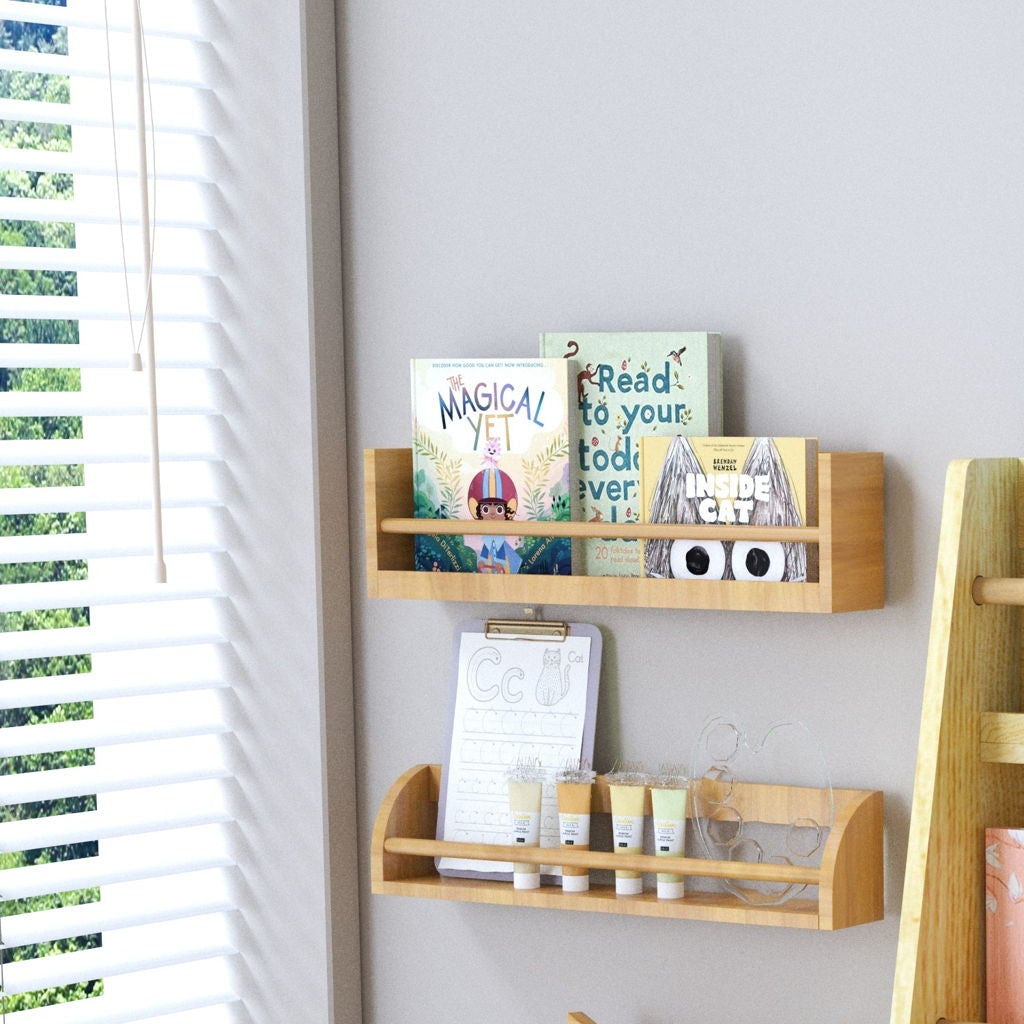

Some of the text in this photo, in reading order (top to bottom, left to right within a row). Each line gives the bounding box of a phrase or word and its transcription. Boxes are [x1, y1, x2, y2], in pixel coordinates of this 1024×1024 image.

[446, 374, 465, 391] THE
[599, 361, 671, 394] Read
[438, 382, 546, 430] MAGICAL
[579, 398, 686, 434] to your
[467, 413, 515, 451] YET
[686, 472, 771, 502] INSIDE
[699, 498, 754, 523] CAT
[567, 650, 584, 663] Cat
